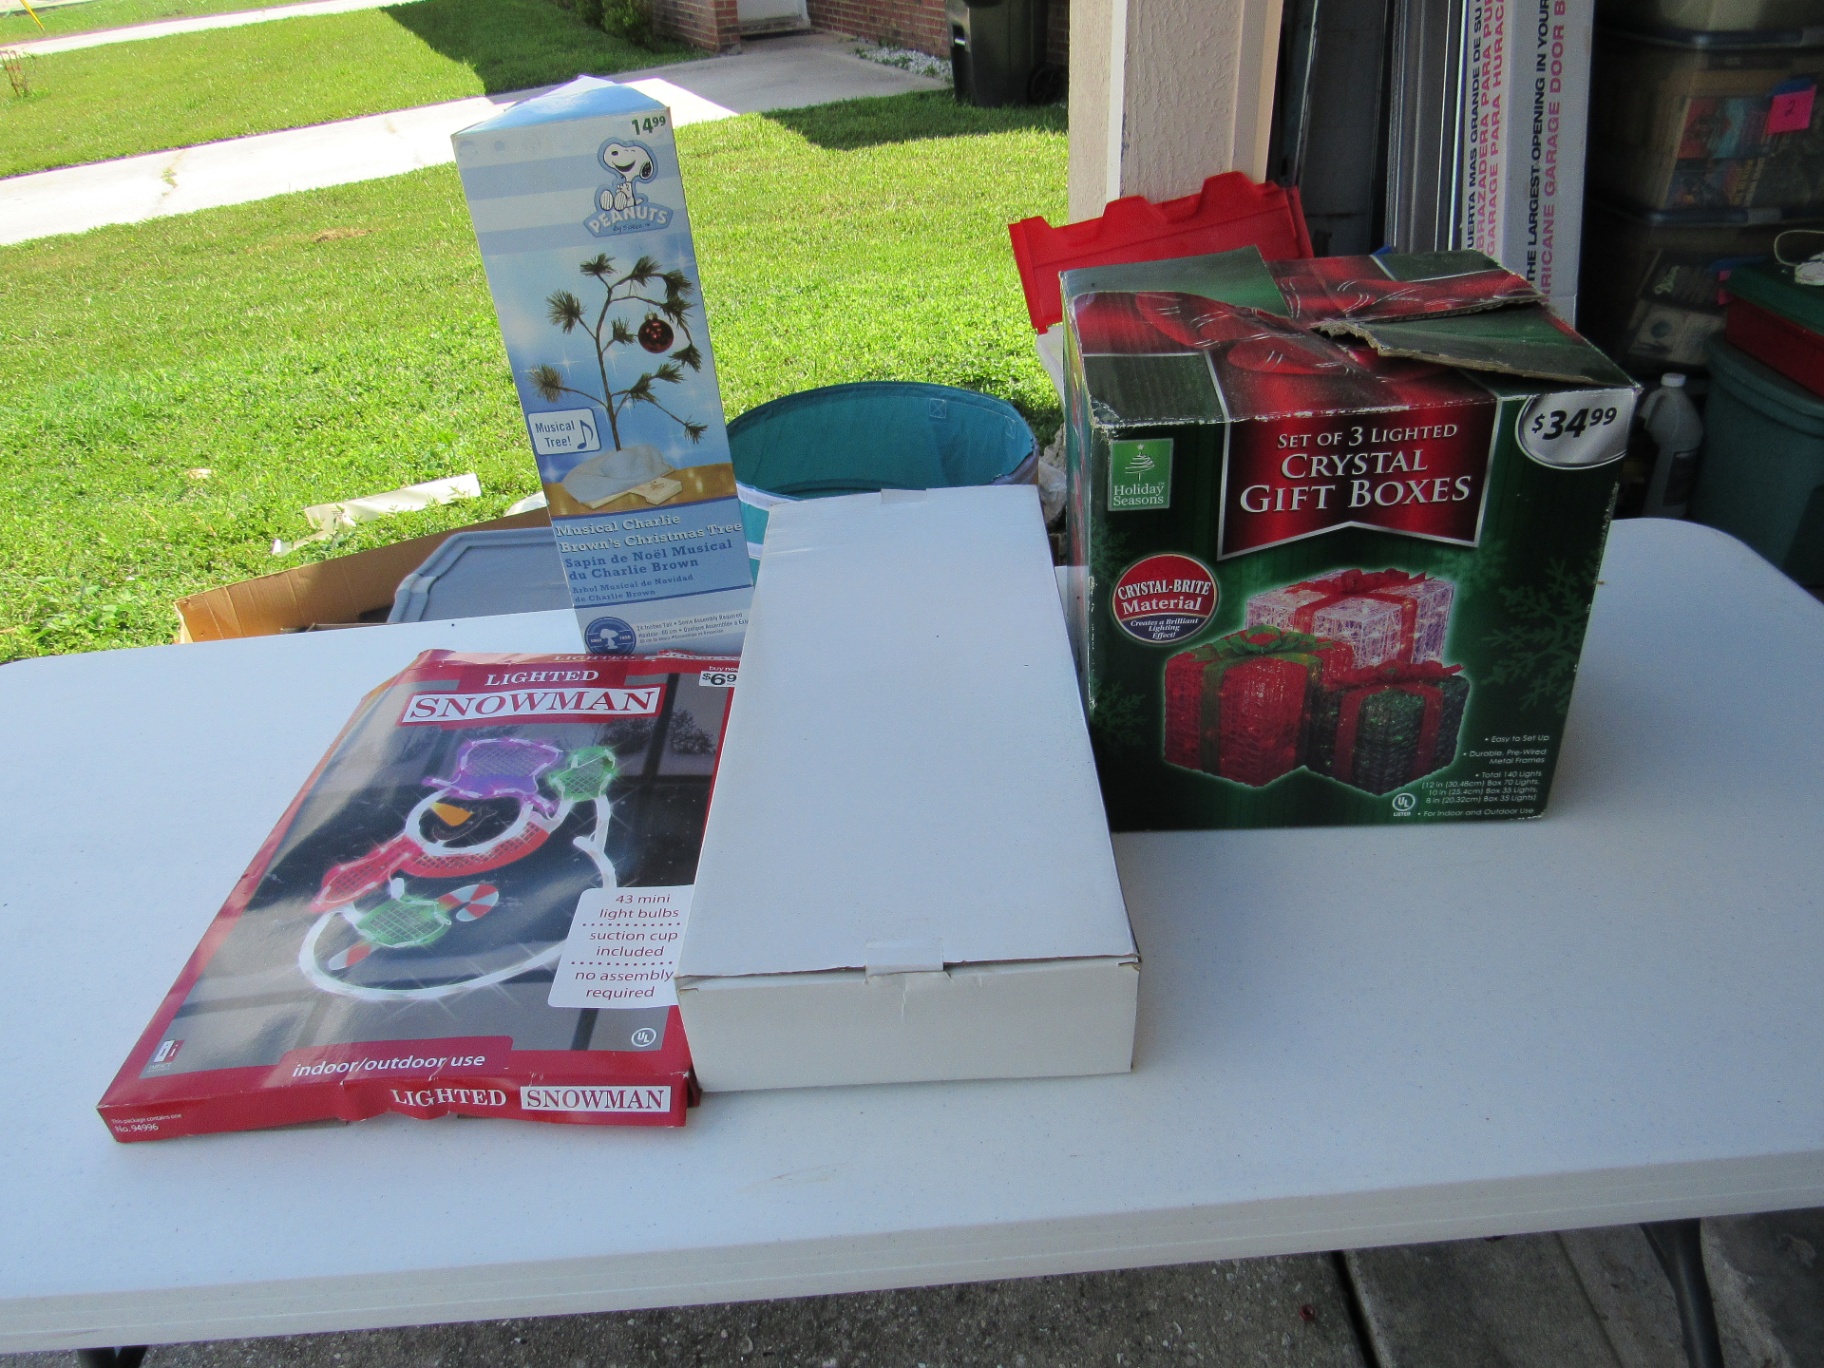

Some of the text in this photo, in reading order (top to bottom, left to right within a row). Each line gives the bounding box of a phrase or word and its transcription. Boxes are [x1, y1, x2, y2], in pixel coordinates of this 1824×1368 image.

[1549, 25, 1564, 93] DOOR
[1481, 45, 1491, 107] PARA
[1467, 7, 1482, 248] UERTA MAS GRANDE DE SU
[1487, 0, 1504, 256] GARAGE PARA HURAC
[1526, 0, 1549, 281] THE LARGEST OPENING IN YOUR
[1544, 101, 1560, 196] GARAGE
[1476, 113, 1489, 249] BRAZADERA
[589, 206, 667, 233] PEANUTS
[535, 420, 575, 433] Musical
[1317, 432, 1343, 447] OF
[1349, 426, 1363, 446] 3
[1371, 423, 1458, 443] LIGHTED
[544, 435, 571, 448] Tree!
[1281, 449, 1428, 479] CRYSTAL
[1114, 483, 1164, 496] Holiday
[1240, 475, 1472, 513] GIFT BOXES
[1113, 495, 1164, 506] Seasons
[555, 514, 681, 537] Musical Charlie
[560, 523, 742, 553] Brown's Christmas Tree
[565, 539, 733, 569] Sapin de Noël Musical
[569, 559, 699, 580] du Charlie Brown
[573, 586, 598, 594] Arbol
[600, 581, 638, 591] Musical
[655, 574, 693, 584] Navidad
[1118, 579, 1211, 600] CRYSTAL-BRITE
[588, 592, 623, 601] Charlie
[626, 590, 656, 598] Brown
[1121, 596, 1202, 615] Material
[1130, 619, 1158, 627] Creates
[1165, 617, 1199, 625] Brilliant
[1148, 624, 1181, 632] Lighting
[1152, 632, 1176, 640] Effect!
[485, 670, 599, 686] LIGHTED
[410, 691, 655, 718] SNOWMAN
[1537, 734, 1550, 742] Up
[1506, 748, 1547, 756] Pre-Wired
[1519, 770, 1542, 778] Lights
[615, 894, 671, 904] 43 mini
[599, 908, 679, 920] light bulbs
[590, 931, 678, 943] suction cup
[596, 946, 664, 957] included
[575, 969, 674, 982] no assembly
[586, 986, 655, 1000] required
[292, 1054, 485, 1078] indoor/outdoor use
[390, 1088, 664, 1110] LIGHTED SNOWMAN
[124, 1117, 146, 1125] package
[146, 1114, 171, 1122] contains
